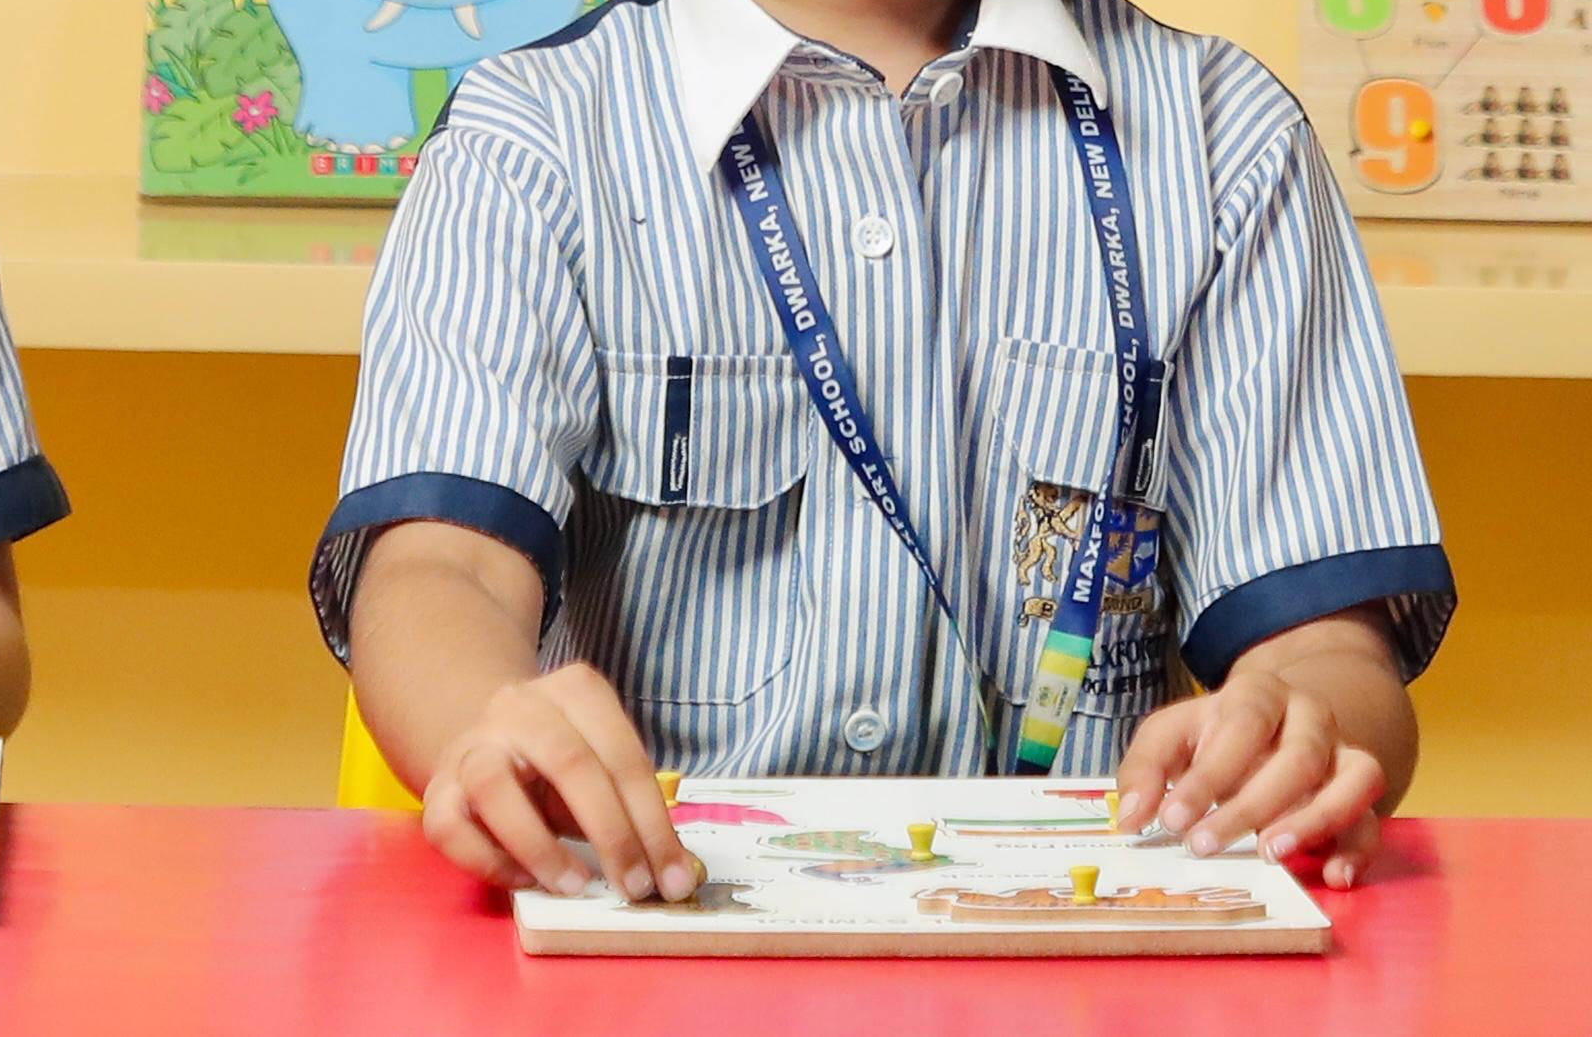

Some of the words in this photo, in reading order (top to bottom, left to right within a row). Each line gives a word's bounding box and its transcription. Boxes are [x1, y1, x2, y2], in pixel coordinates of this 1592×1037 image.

[730, 144, 769, 203] NEW
[1084, 143, 1114, 199] NEW
[1356, 77, 1439, 198] 9
[758, 204, 818, 332] DWARKA,
[1101, 208, 1136, 330] DWARKA,
[808, 332, 868, 456] SCHOOL,
